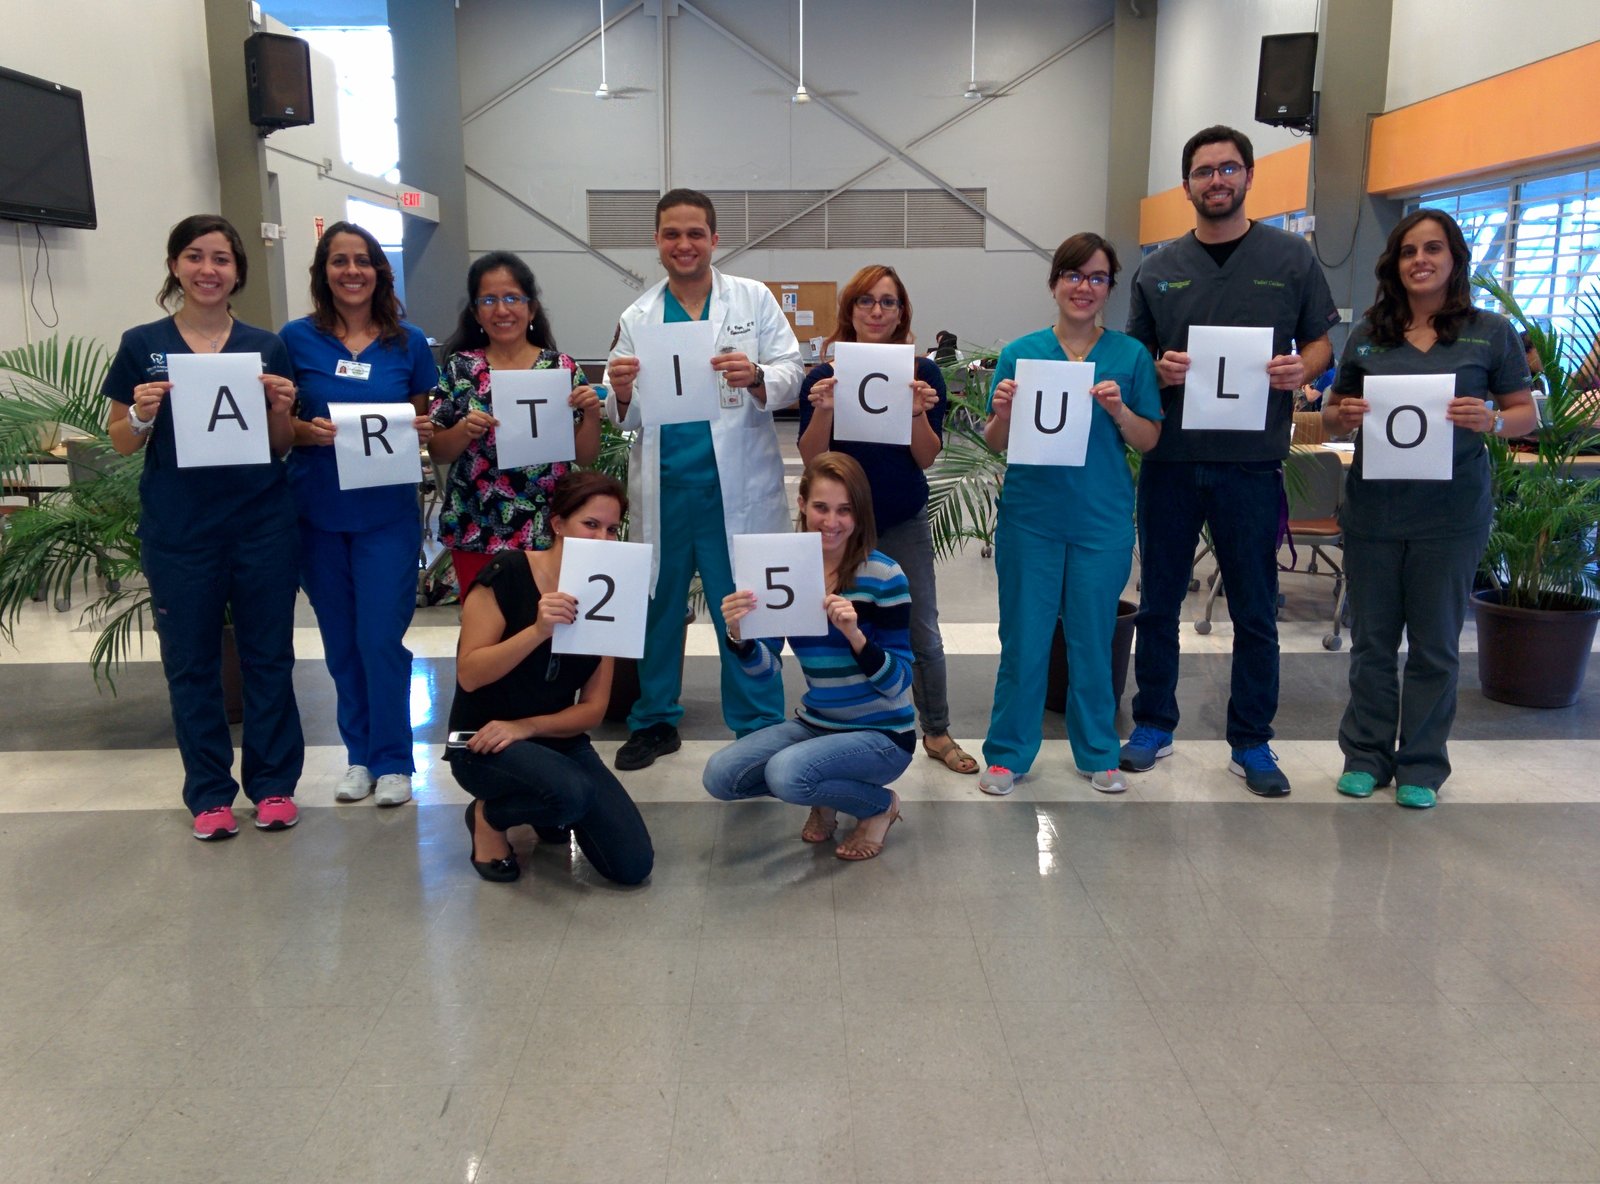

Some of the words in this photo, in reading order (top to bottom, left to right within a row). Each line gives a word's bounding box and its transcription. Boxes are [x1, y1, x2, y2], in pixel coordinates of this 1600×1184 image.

[403, 192, 420, 206] EXIT
[673, 355, 683, 396] I
[858, 373, 888, 414] C
[1217, 357, 1240, 399] L
[208, 386, 248, 432] A
[516, 399, 547, 438] T
[1034, 391, 1068, 434] U
[1386, 405, 1427, 449] O
[361, 413, 393, 456] R
[584, 574, 615, 622] 2
[766, 567, 794, 610] 5
